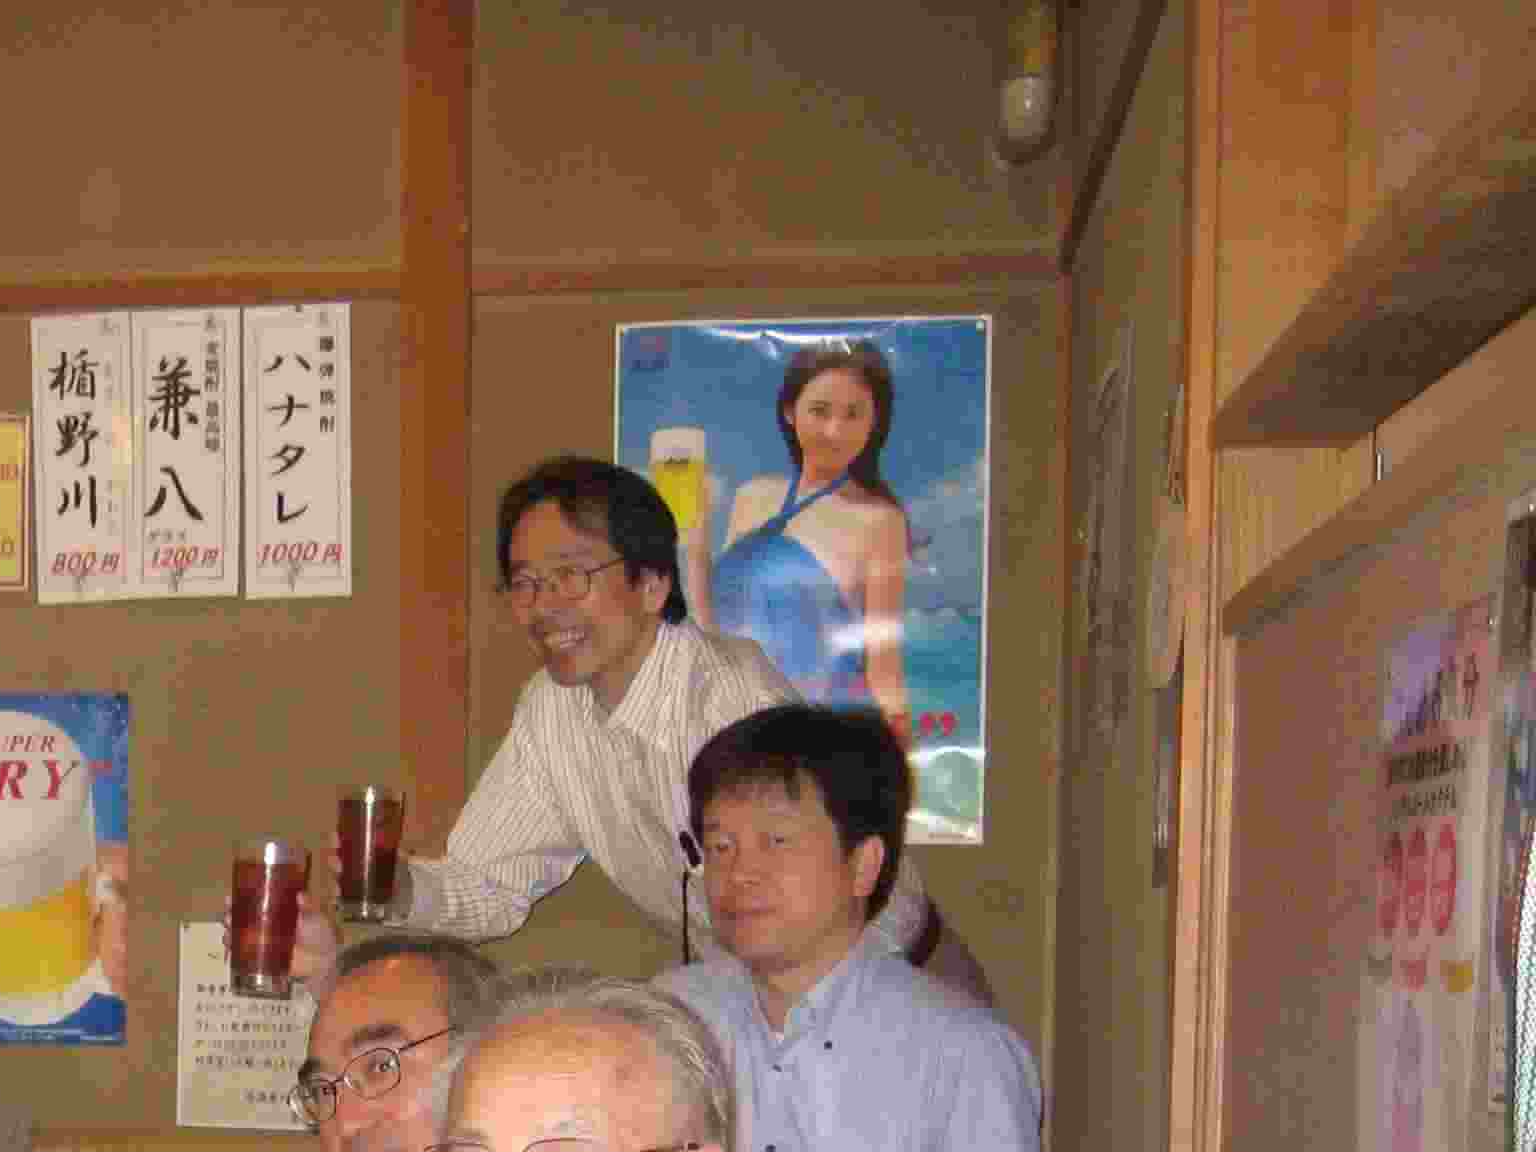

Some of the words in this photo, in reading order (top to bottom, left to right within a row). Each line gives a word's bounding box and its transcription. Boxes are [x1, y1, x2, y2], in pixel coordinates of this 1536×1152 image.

[49, 349, 99, 530] 楯野川
[144, 353, 204, 522] 兼八
[263, 353, 312, 525] ハナタレ
